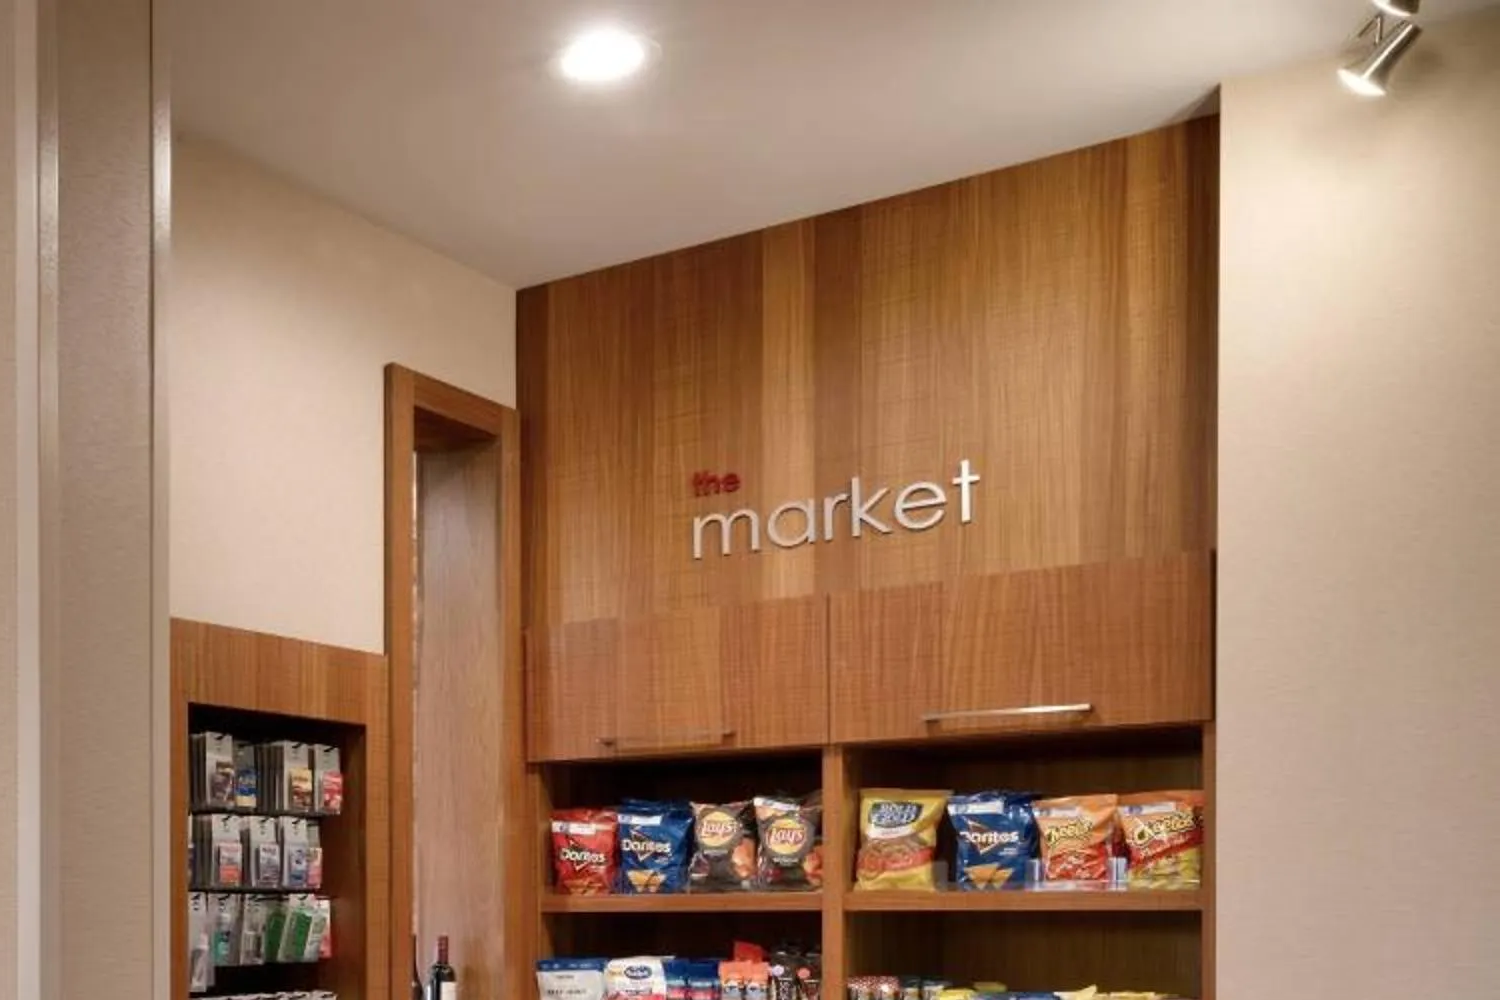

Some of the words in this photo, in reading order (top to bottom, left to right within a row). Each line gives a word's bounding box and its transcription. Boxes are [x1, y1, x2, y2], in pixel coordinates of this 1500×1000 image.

[693, 471, 741, 495] the
[693, 459, 981, 560] market
[560, 847, 606, 864] Doritos
[621, 838, 672, 854] Doritos
